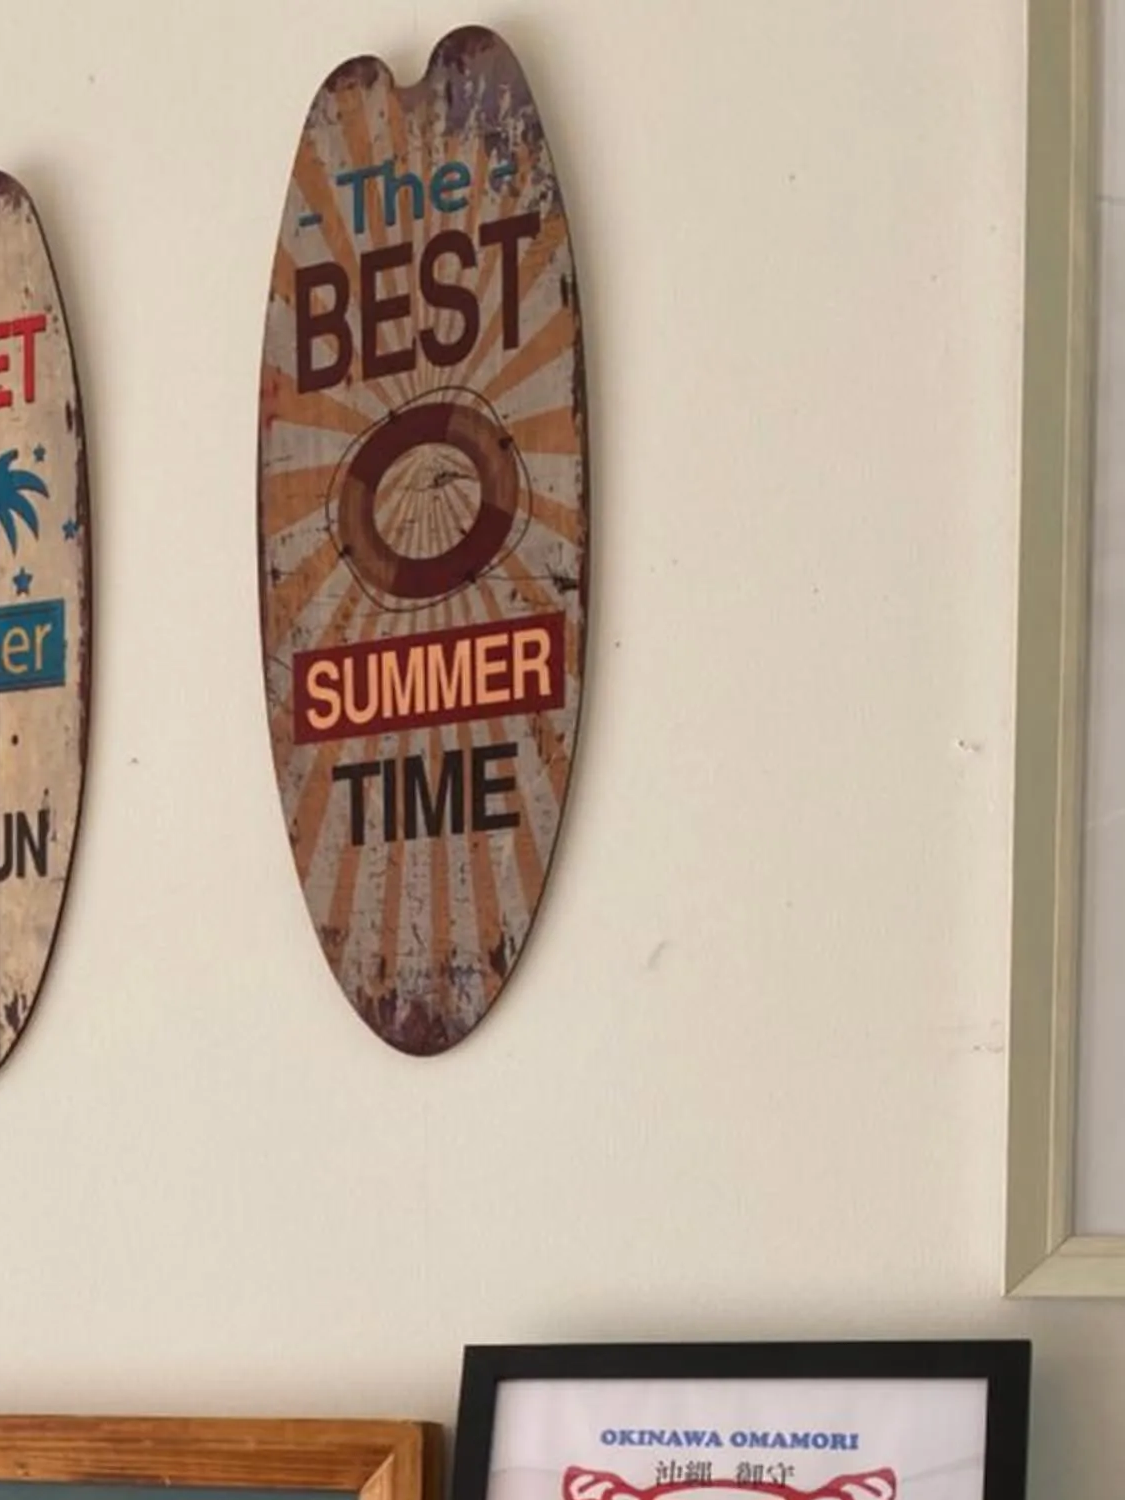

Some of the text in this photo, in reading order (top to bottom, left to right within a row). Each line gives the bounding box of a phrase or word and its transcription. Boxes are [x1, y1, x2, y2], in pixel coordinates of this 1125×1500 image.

[336, 158, 472, 235] The
[295, 211, 541, 394] BEST
[305, 626, 553, 731] SUMMER
[332, 742, 522, 847] TIME
[600, 1429, 859, 1450] OKINAWA OMAMORI
